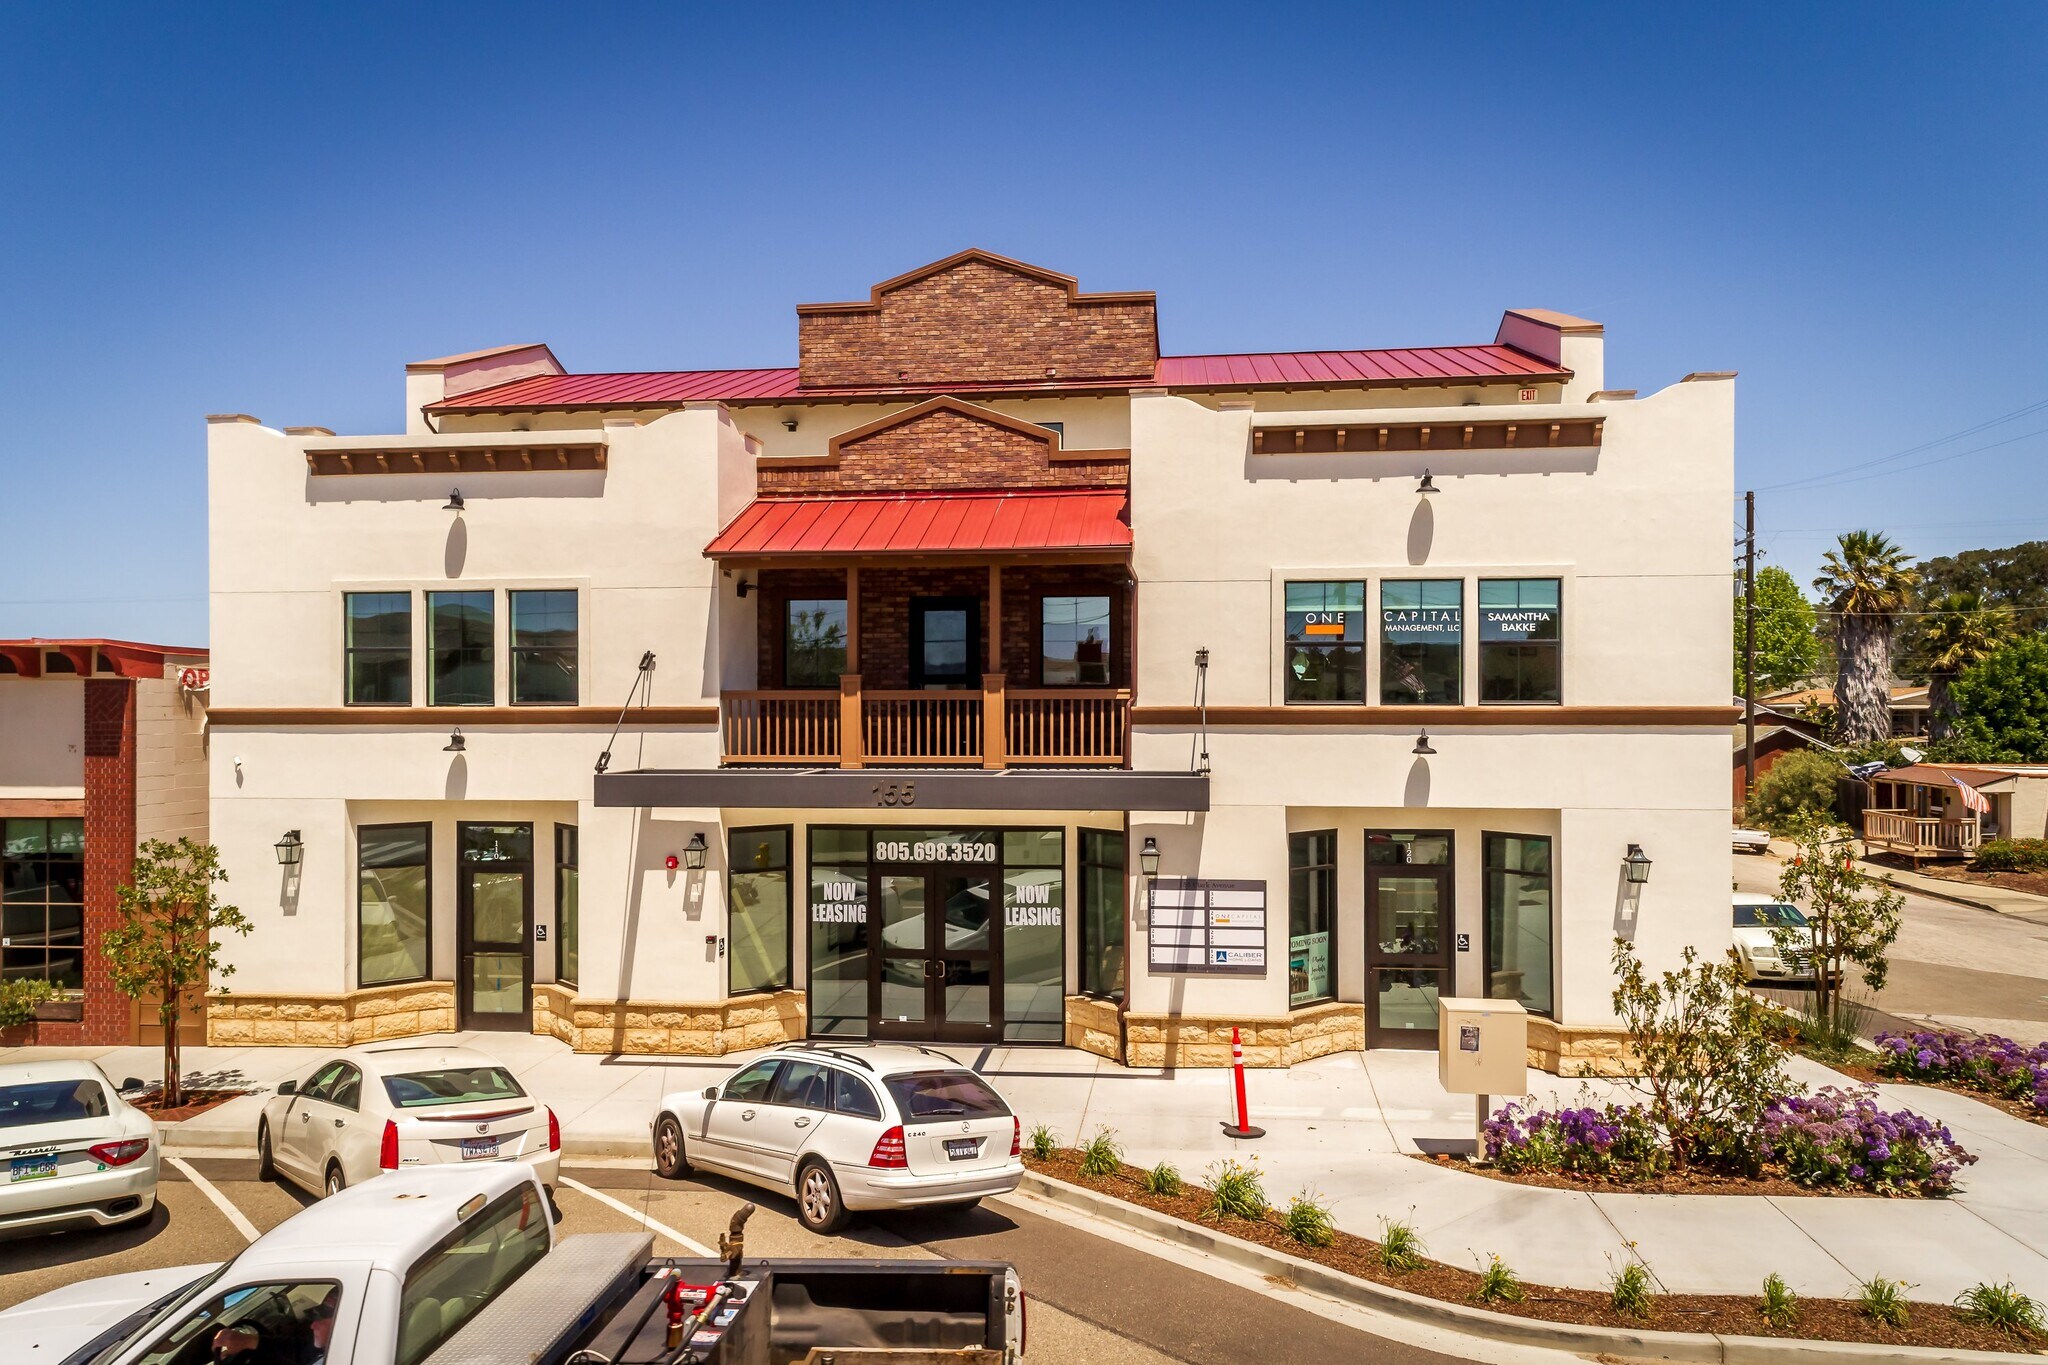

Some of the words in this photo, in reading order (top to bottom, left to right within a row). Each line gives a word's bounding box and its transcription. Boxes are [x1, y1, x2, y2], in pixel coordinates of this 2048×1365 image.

[1521, 390, 1536, 401] EXIT
[1305, 612, 1344, 625] ONE
[1383, 611, 1460, 622] CAPITAL
[1487, 612, 1550, 622] SAMANTHA
[1384, 624, 1445, 633] MANAGEMENT,
[1447, 624, 1460, 632] LLC
[1501, 623, 1536, 632] BAKKE
[872, 780, 916, 807] 155
[875, 841, 996, 862] 805.698.3520
[823, 882, 856, 901] NOW
[1016, 885, 1050, 904] NOW
[812, 904, 867, 923] LEASING
[1005, 907, 1061, 926] LEASING
[1291, 939, 1311, 949] OMING
[1312, 936, 1328, 945] SOON
